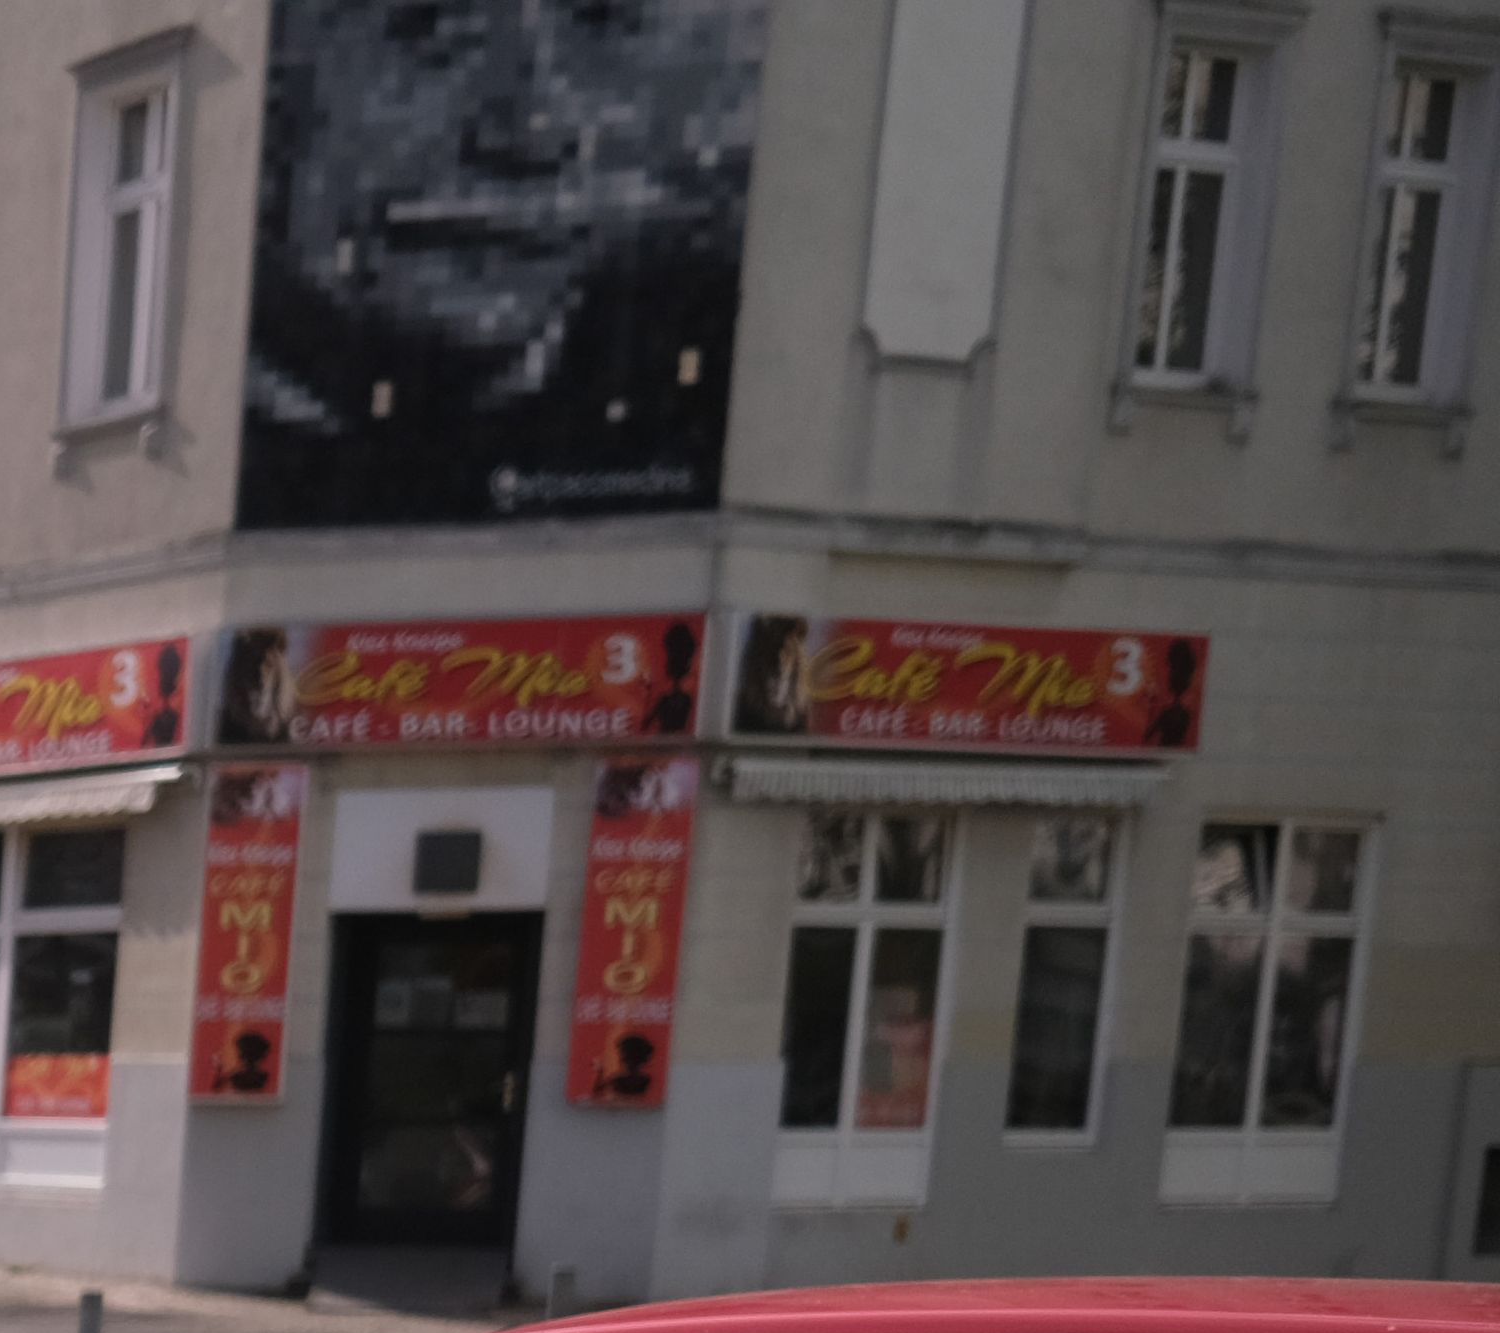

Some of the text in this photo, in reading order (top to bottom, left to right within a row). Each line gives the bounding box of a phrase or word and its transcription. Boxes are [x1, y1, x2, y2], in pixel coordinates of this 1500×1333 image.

[109, 649, 139, 708] 3
[296, 649, 430, 706] Café
[601, 633, 639, 685] 3
[1106, 636, 1145, 695] 3
[288, 707, 372, 741] CAFÉ
[487, 708, 634, 739] LOUNGE
